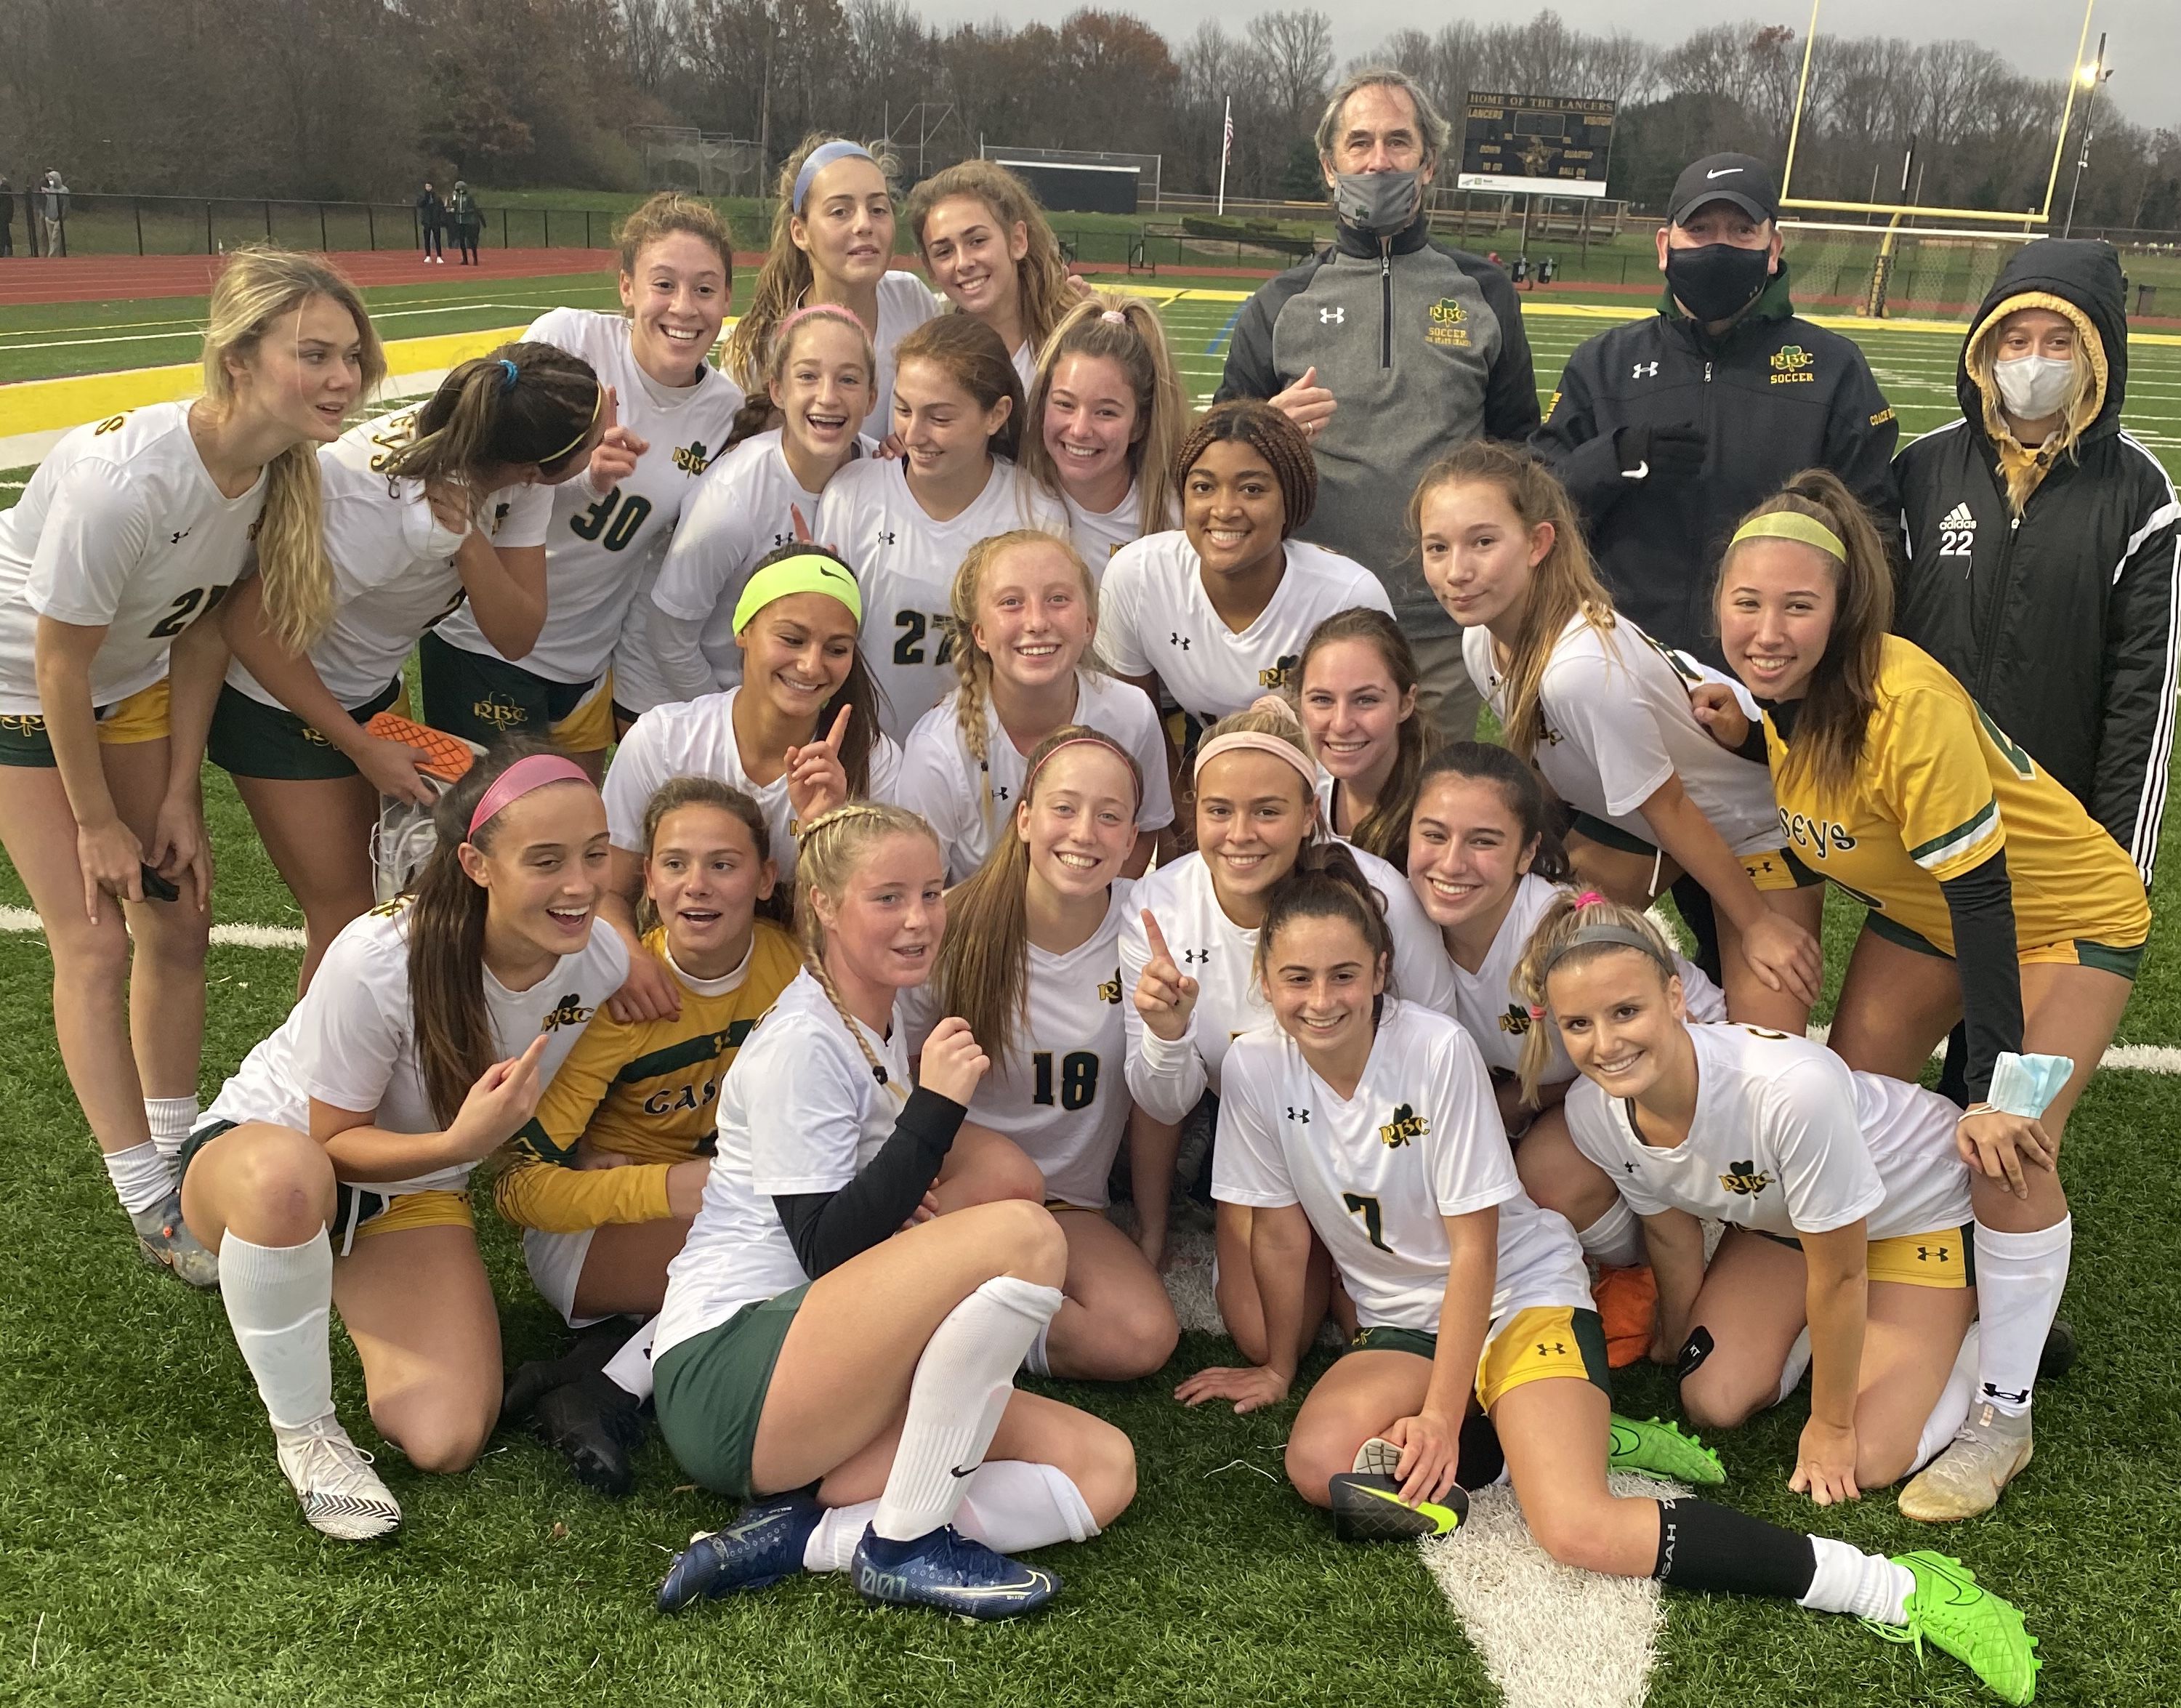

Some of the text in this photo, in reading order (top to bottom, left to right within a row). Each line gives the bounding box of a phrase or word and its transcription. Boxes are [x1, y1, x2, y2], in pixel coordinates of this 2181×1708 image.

[1470, 94, 1613, 111] HOME OF THE LANCERS
[1429, 305, 1468, 321] RBC
[1428, 327, 1467, 339] SOCCER
[1770, 353, 1814, 366] RBC
[1770, 372, 1814, 384] SOCCER
[570, 486, 652, 551] 30
[1939, 519, 1977, 531] adidas
[1939, 531, 1974, 555] 22
[473, 702, 528, 722] RBC
[1033, 1052, 1100, 1111] 18
[1379, 1116, 1431, 1145] RBC
[1718, 1169, 1776, 1192] RBC
[1343, 1192, 1395, 1254] 7
[1690, 1344, 1701, 1358] KT
